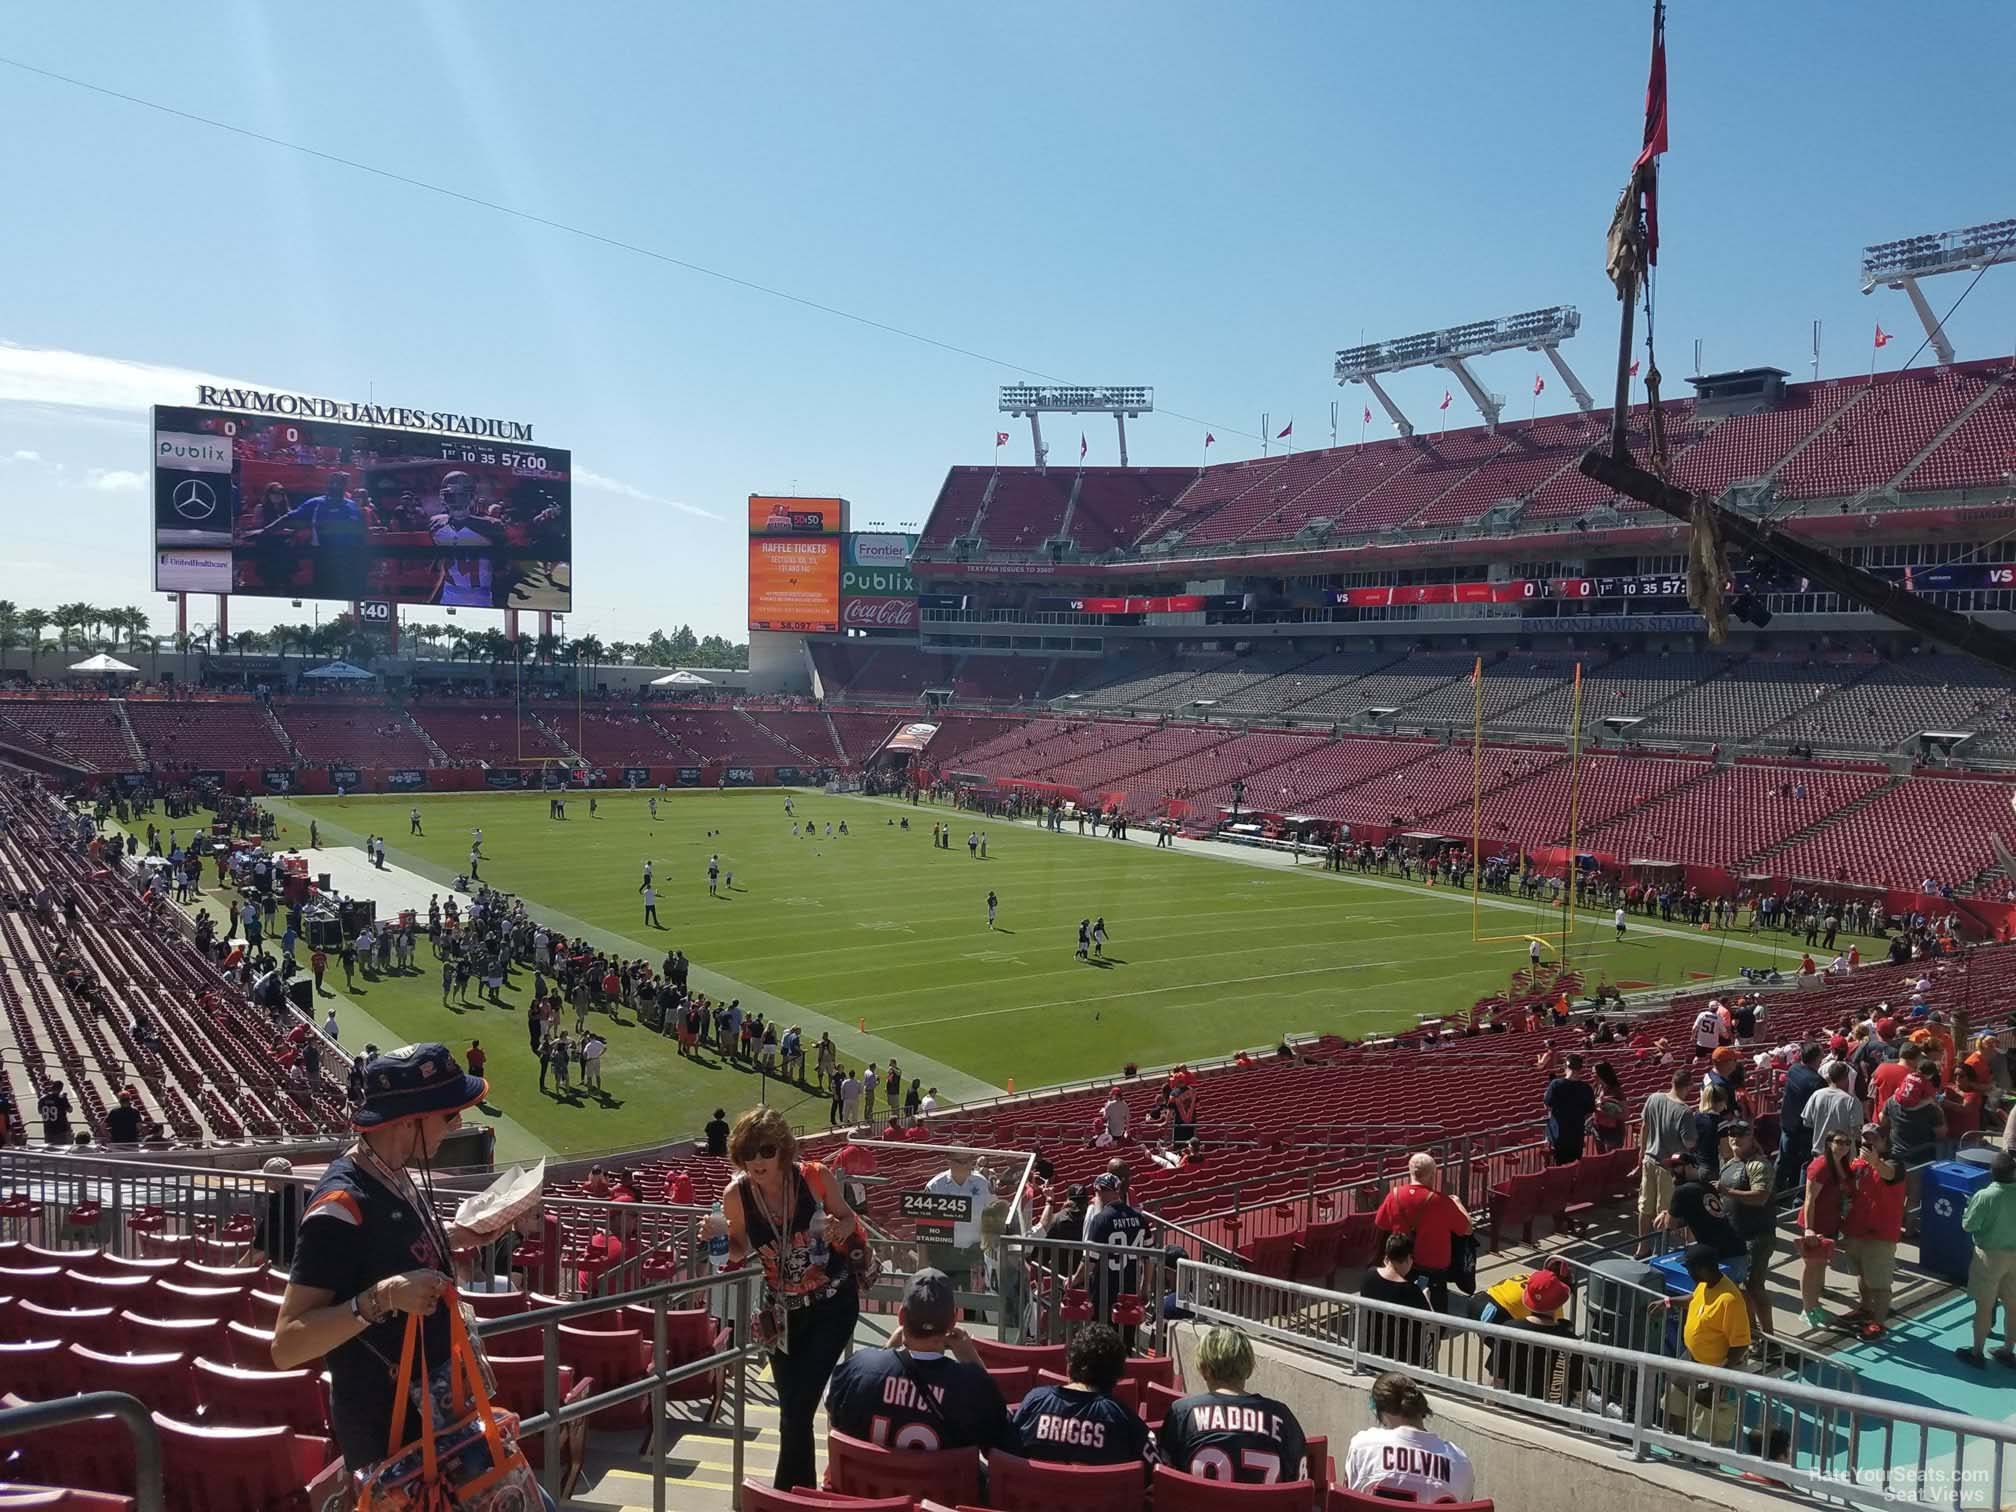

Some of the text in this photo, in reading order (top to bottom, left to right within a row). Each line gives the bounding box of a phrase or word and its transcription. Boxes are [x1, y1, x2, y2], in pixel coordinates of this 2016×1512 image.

[198, 384, 534, 441] RAYMOND JAMES STADIUM
[224, 421, 236, 436] 0
[286, 428, 298, 442] 0
[160, 441, 225, 461] Publix
[462, 451, 476, 462] 10
[480, 453, 496, 464] 35
[502, 453, 547, 469] 57:00
[762, 543, 827, 554] RAFFLE TICKETS
[859, 543, 904, 555] Frontier
[843, 572, 914, 591] Publix
[1990, 569, 2014, 583] VS
[1524, 583, 1534, 596] 0
[1580, 582, 1590, 595] 0
[1623, 584, 1636, 594] 10
[1643, 583, 1658, 594] 35
[1337, 593, 1349, 602] VS
[366, 604, 388, 618] 40
[844, 599, 915, 625] Coca-Cola
[1071, 601, 1084, 609] VS
[1701, 1020, 1715, 1034] 51
[904, 1196, 967, 1212] 244-245
[1113, 1217, 1141, 1229] PAYTON
[916, 1235, 953, 1243] STANDING
[1036, 1414, 1105, 1448] BRIGGS
[1193, 1405, 1284, 1443] WADDLE
[1382, 1445, 1451, 1483] COLVIN
